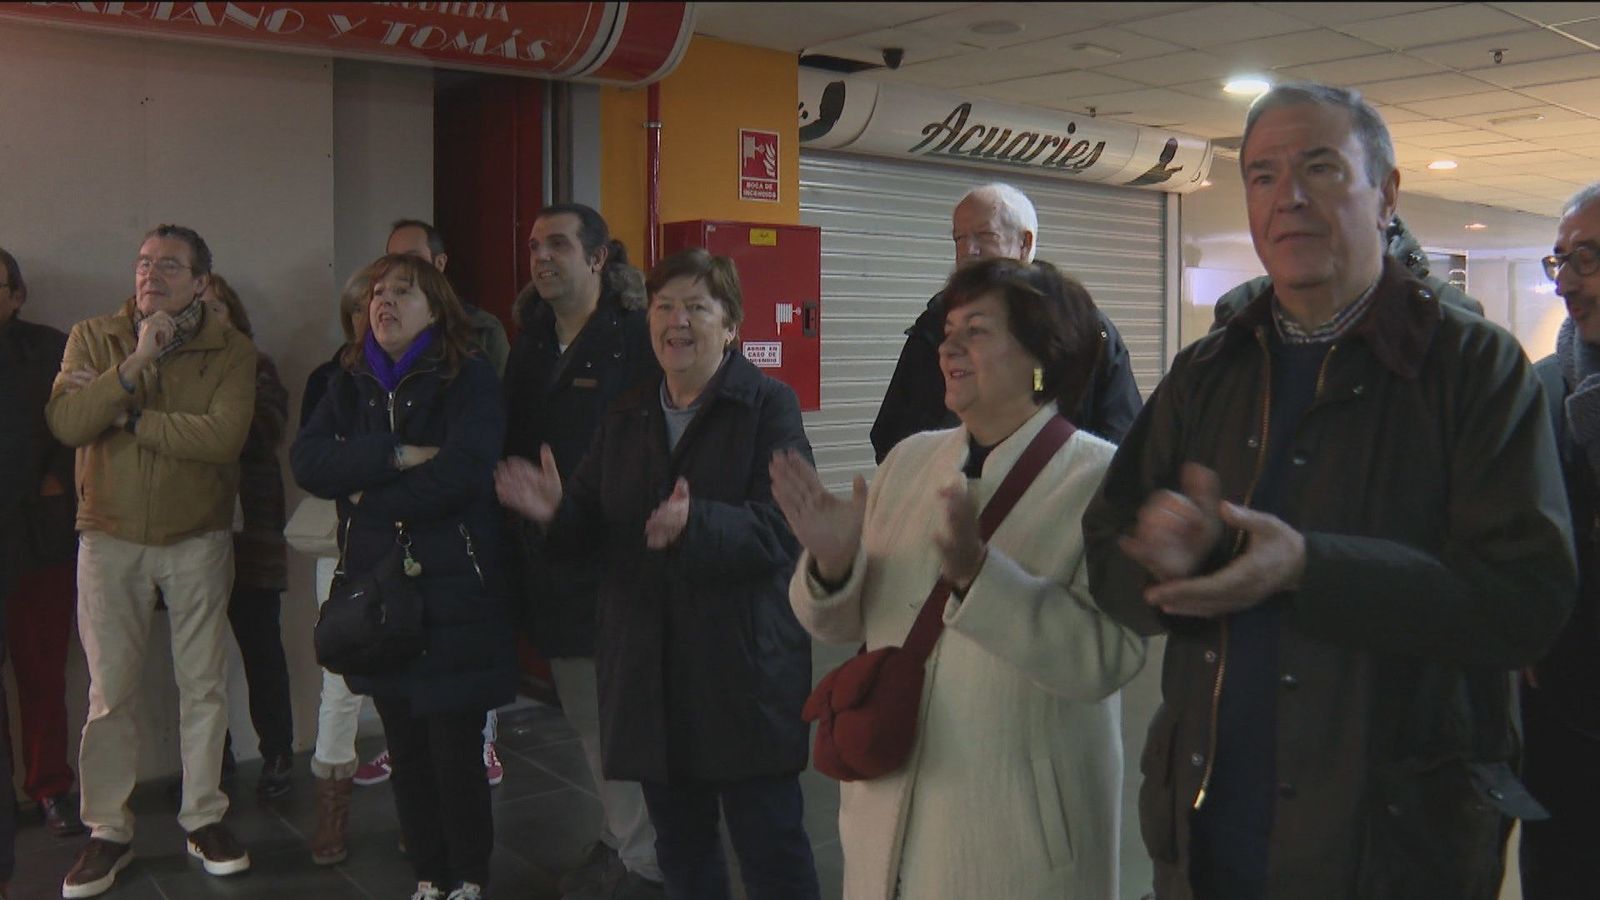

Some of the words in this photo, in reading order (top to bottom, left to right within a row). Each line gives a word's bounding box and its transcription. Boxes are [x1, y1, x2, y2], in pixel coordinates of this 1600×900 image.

[328, 14, 367, 39] Y
[380, 20, 552, 61] TOMÁS
[908, 102, 1106, 171] Acuaries
[764, 183, 773, 191] DE
